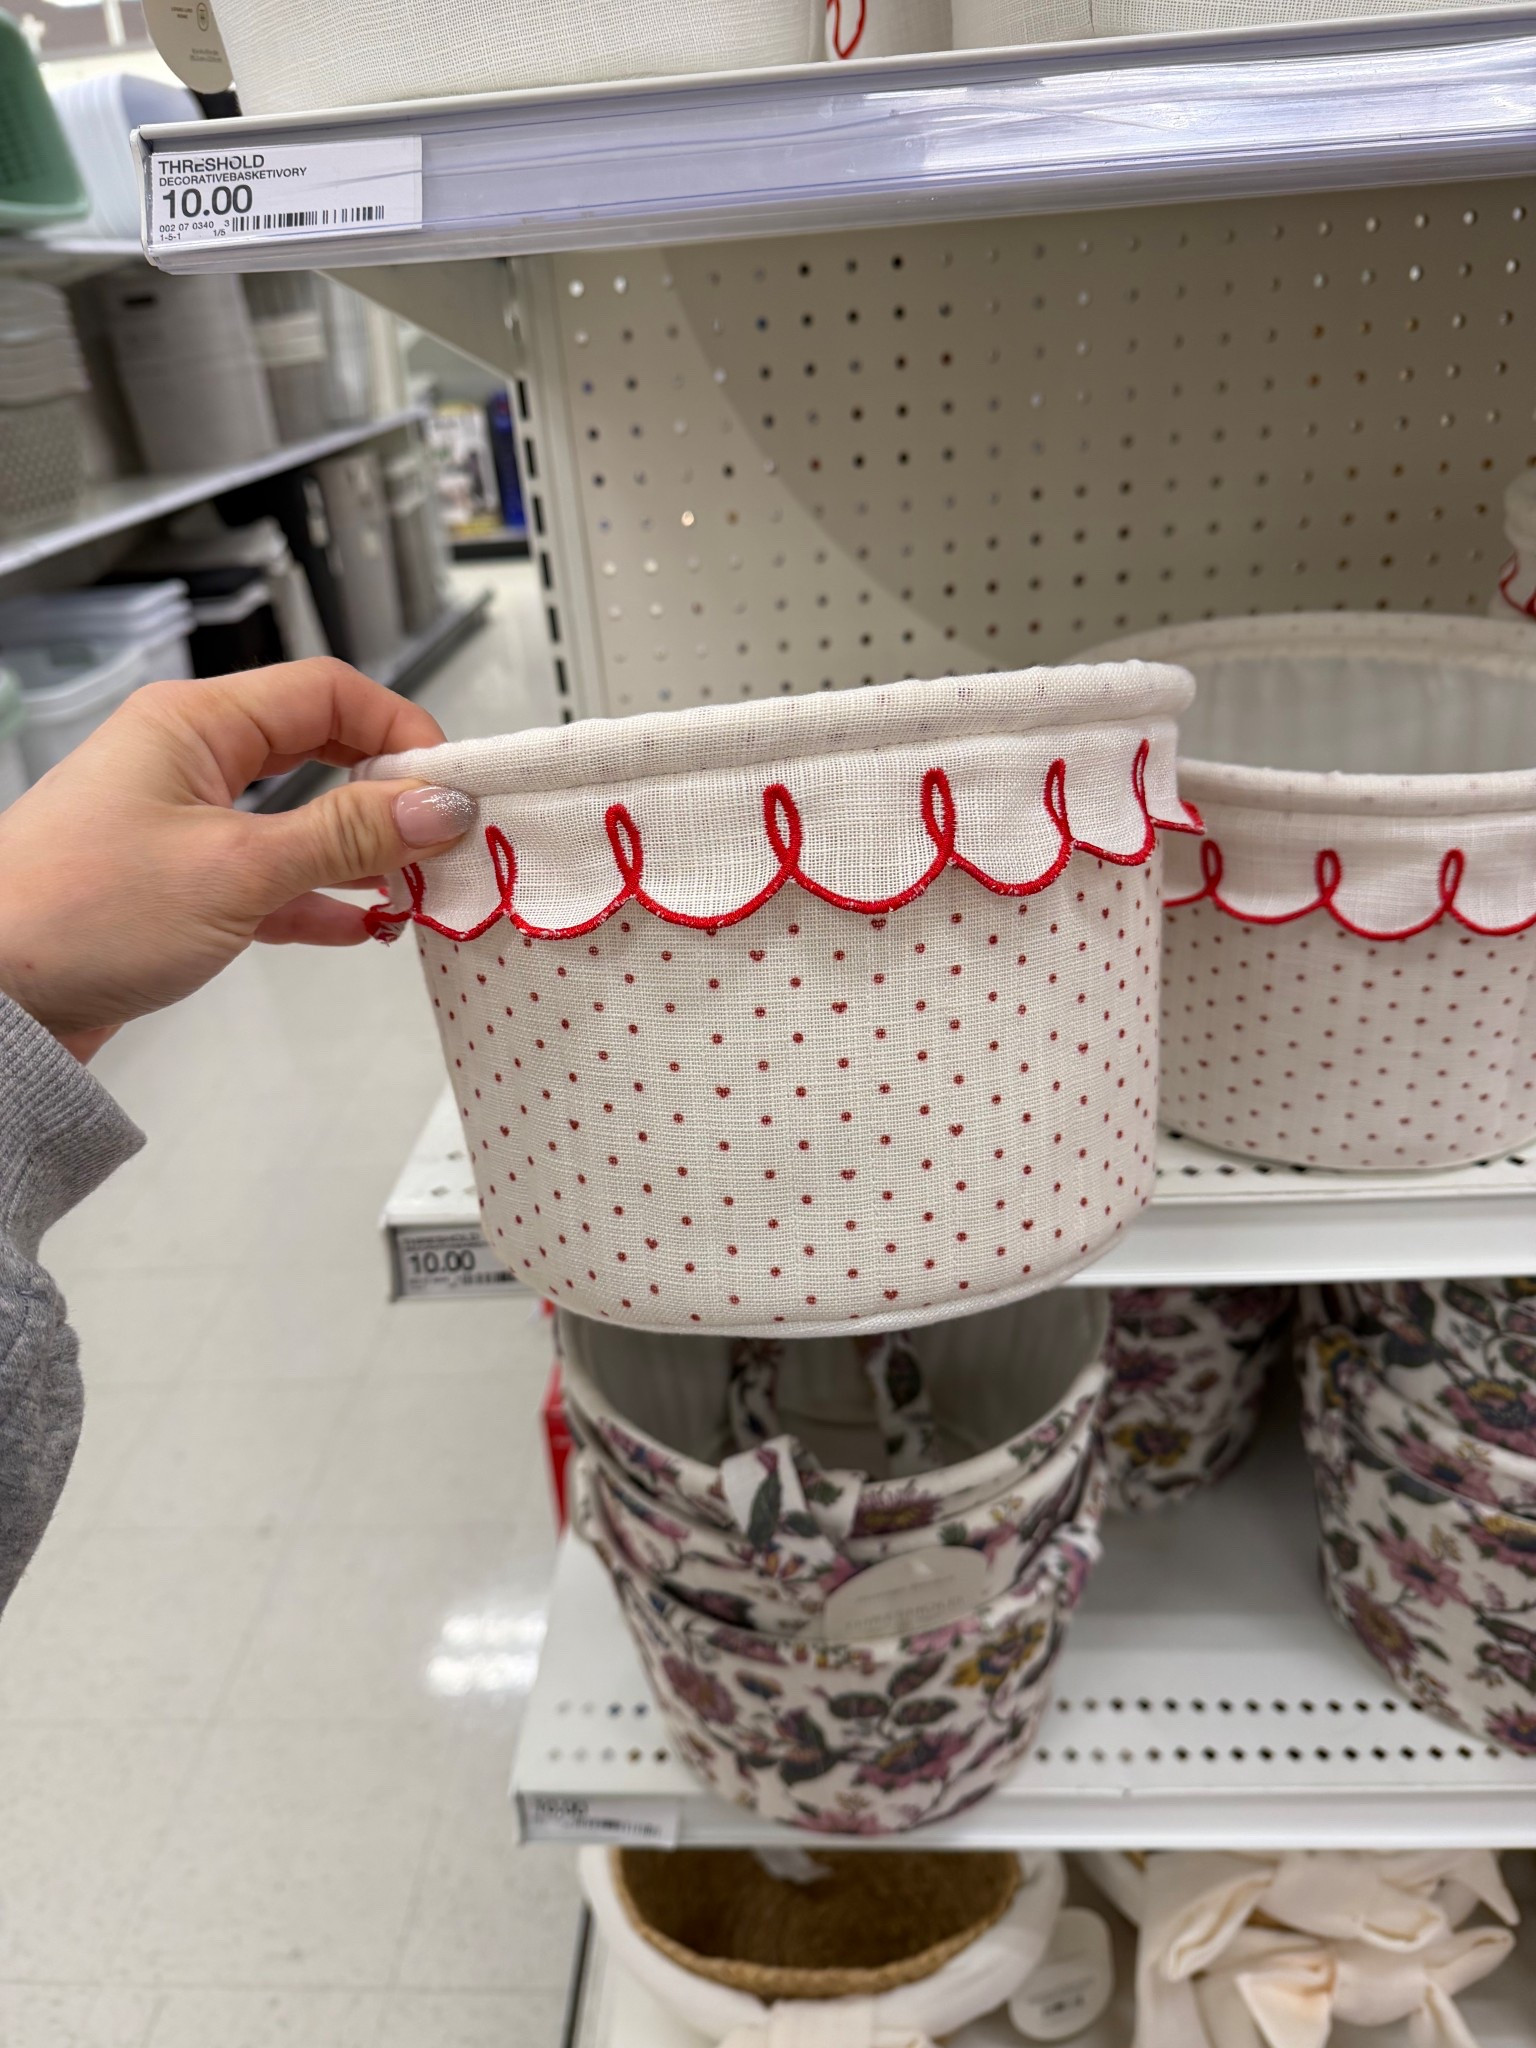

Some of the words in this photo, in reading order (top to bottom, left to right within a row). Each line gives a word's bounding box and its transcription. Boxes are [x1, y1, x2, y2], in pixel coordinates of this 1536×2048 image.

[158, 155, 265, 174] THRESHOLD
[159, 167, 308, 187] DECORATIVEBASKETIVORY
[162, 184, 253, 219] 10.00
[159, 224, 176, 233] 002
[178, 223, 190, 231] 07
[192, 221, 215, 230] 0340
[224, 219, 230, 227] 3
[160, 232, 181, 241] 1-5-1
[213, 228, 226, 237] 1/5
[410, 1249, 476, 1274] 10.00
